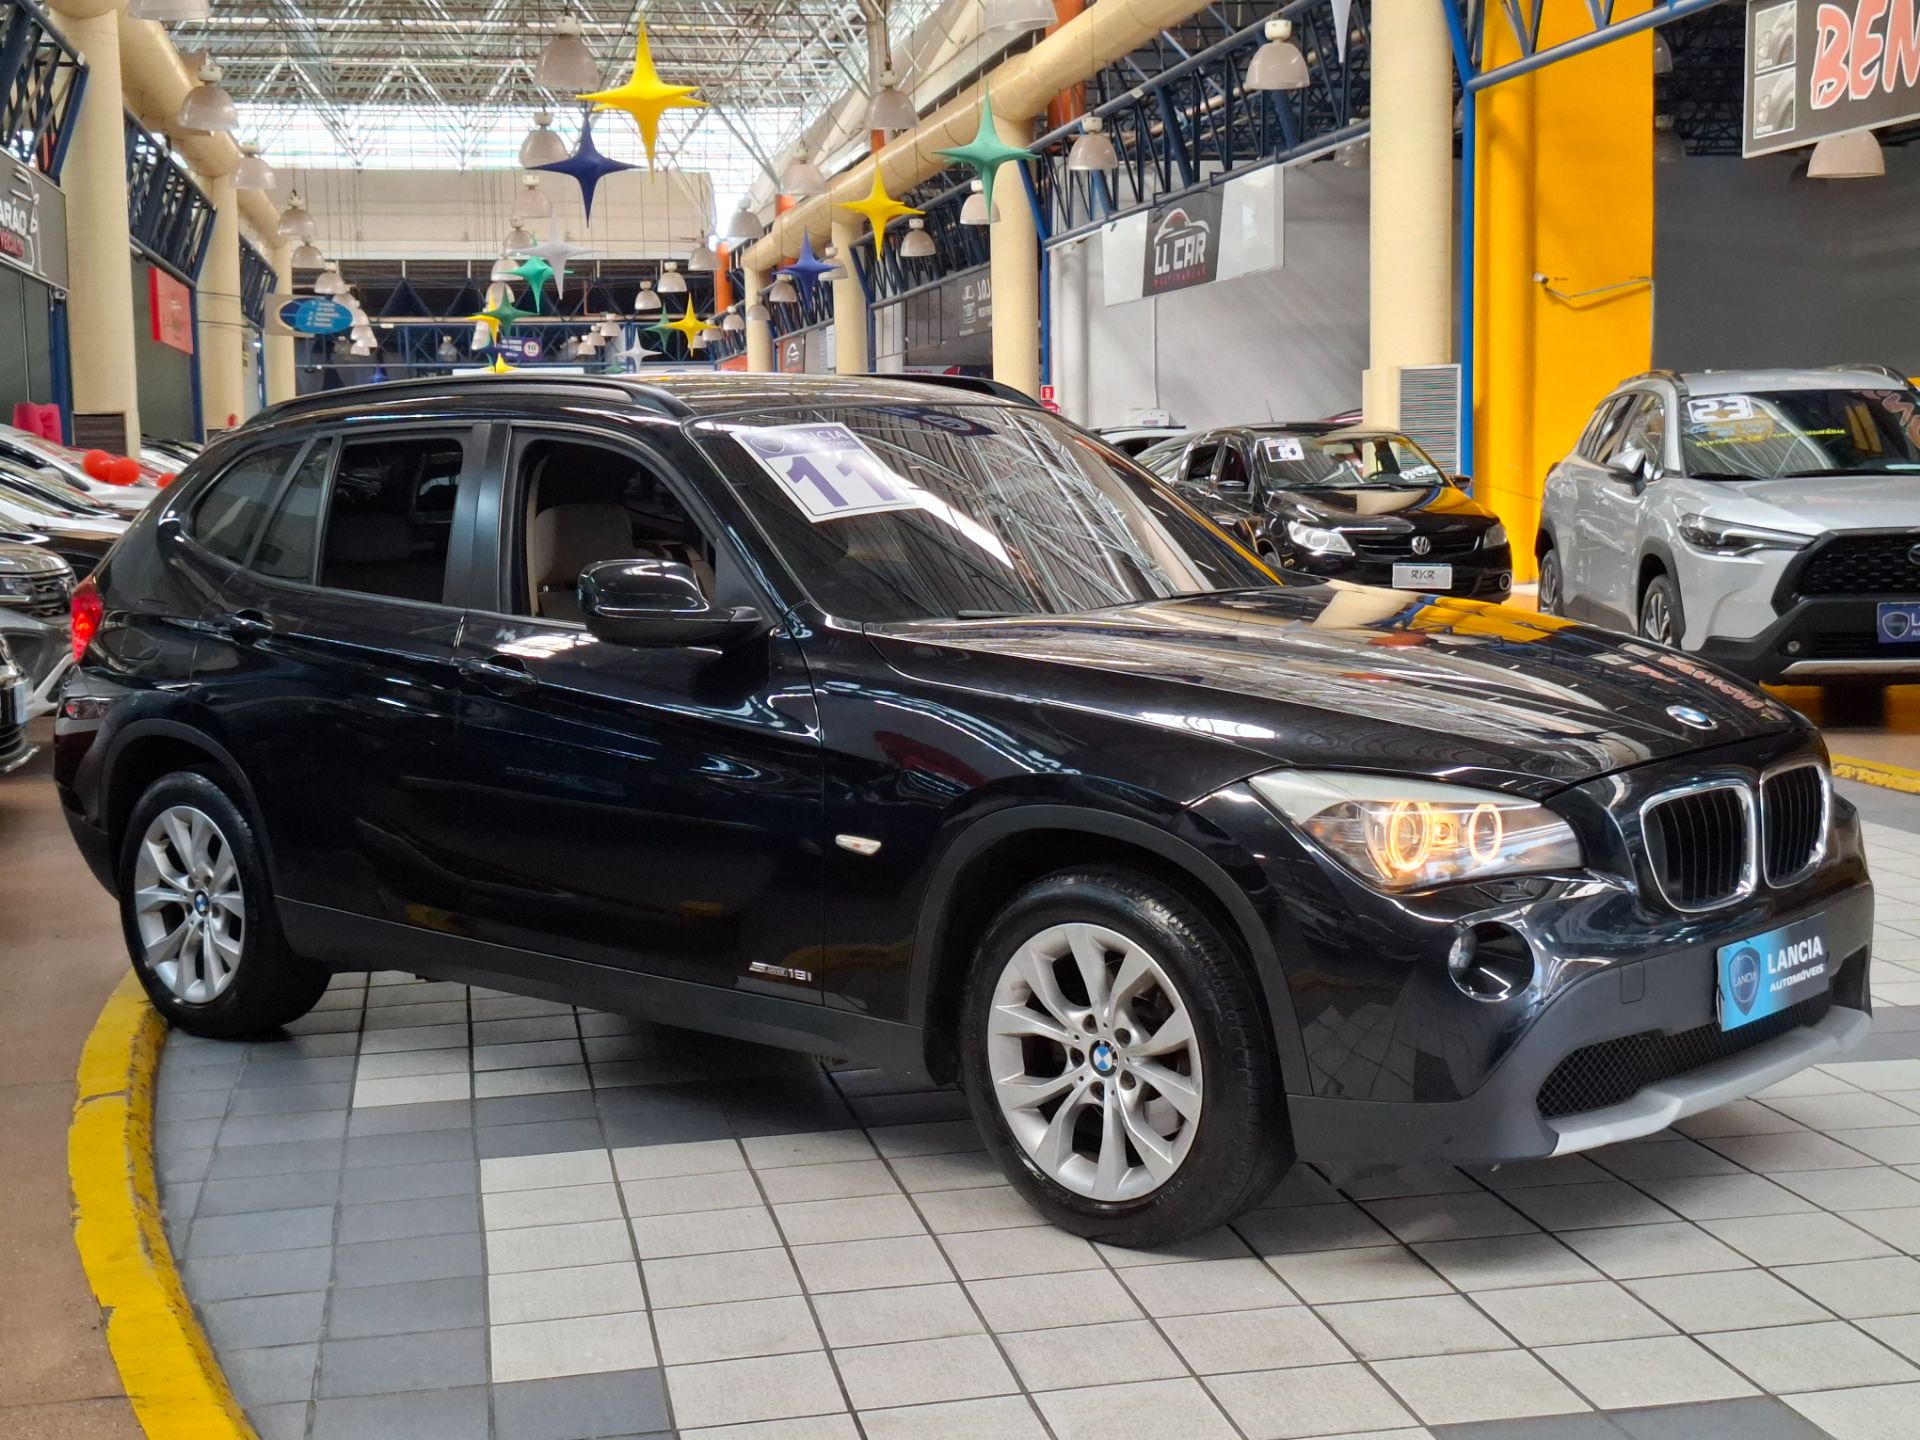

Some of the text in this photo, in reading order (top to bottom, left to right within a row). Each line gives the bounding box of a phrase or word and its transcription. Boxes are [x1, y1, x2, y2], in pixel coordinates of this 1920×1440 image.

[1173, 232, 1207, 270] CAR
[1693, 399, 1750, 420] 23
[784, 430, 850, 443] ANCIA
[1911, 612, 1920, 627] L
[1767, 935, 1823, 975] LANCIA
[1769, 963, 1825, 993] AUTOMÓVEIS
